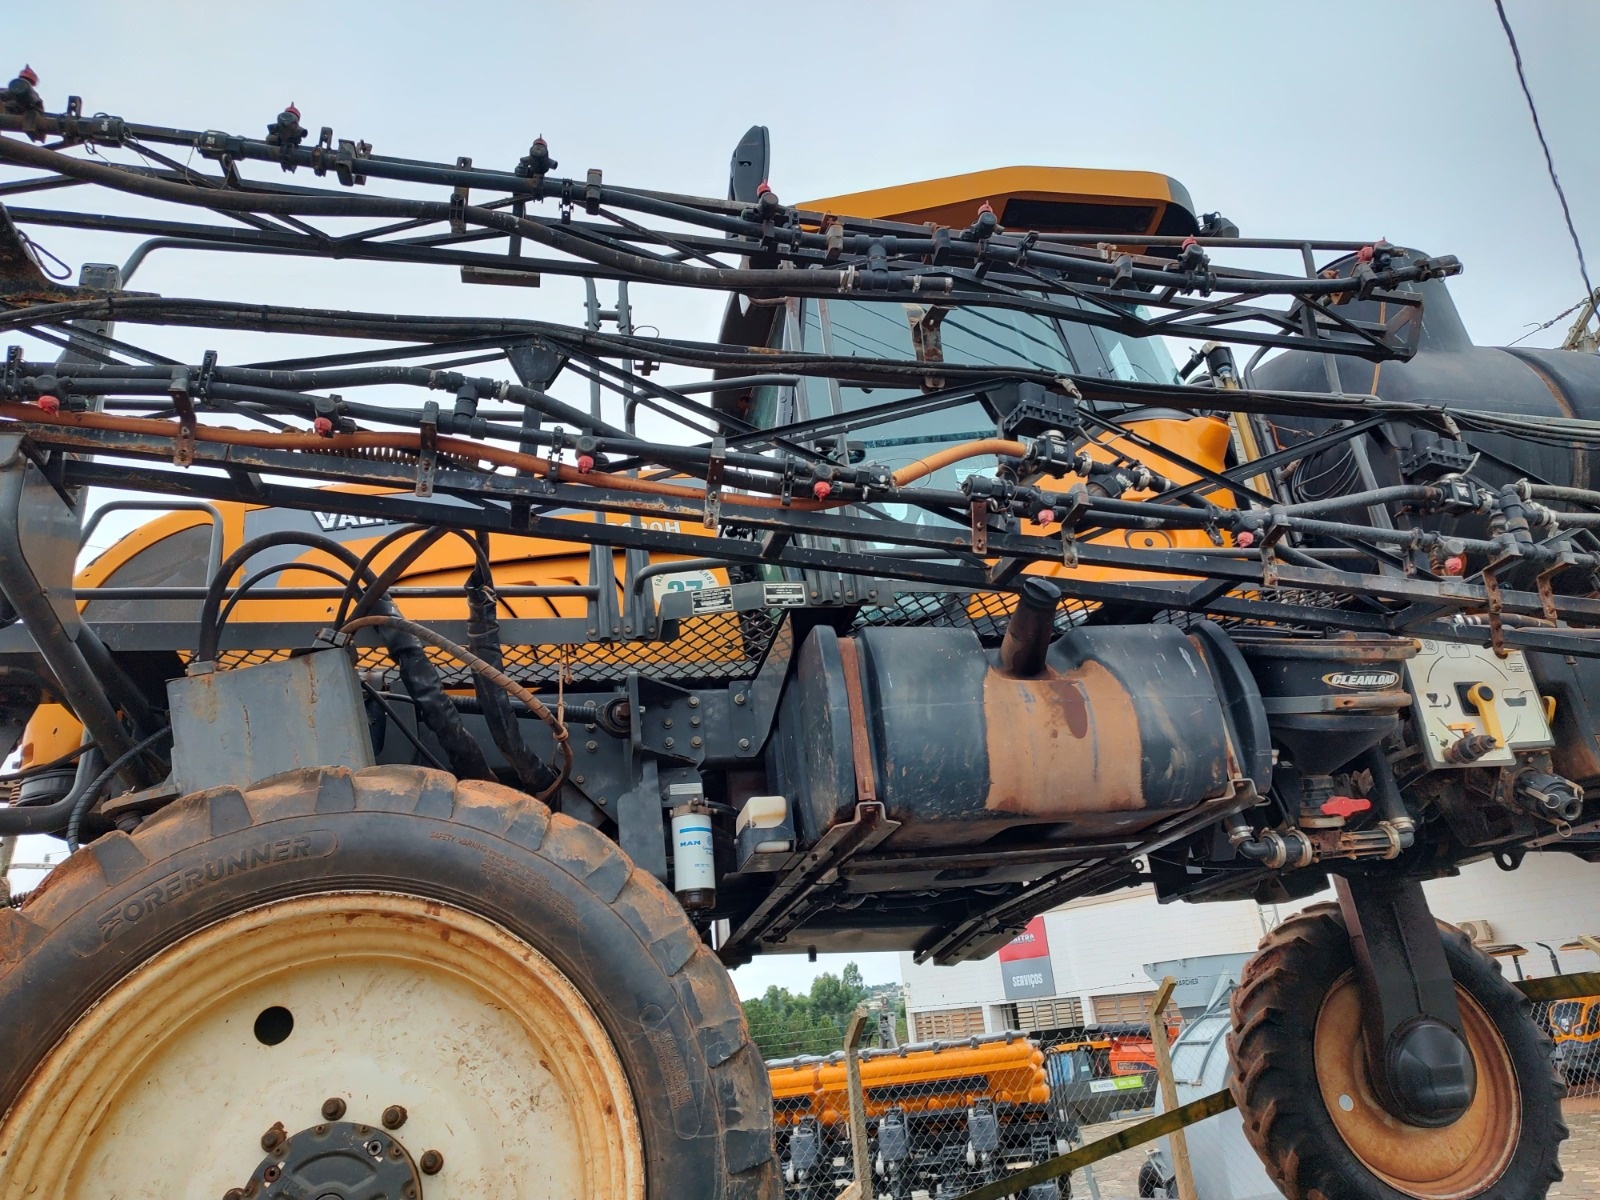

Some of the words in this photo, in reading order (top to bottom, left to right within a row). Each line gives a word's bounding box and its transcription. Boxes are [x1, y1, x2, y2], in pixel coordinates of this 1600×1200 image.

[1331, 674, 1397, 686] CLEANLOAD
[97, 836, 312, 943] FORERUNNER
[1012, 973, 1044, 989] SERVIÇOS
